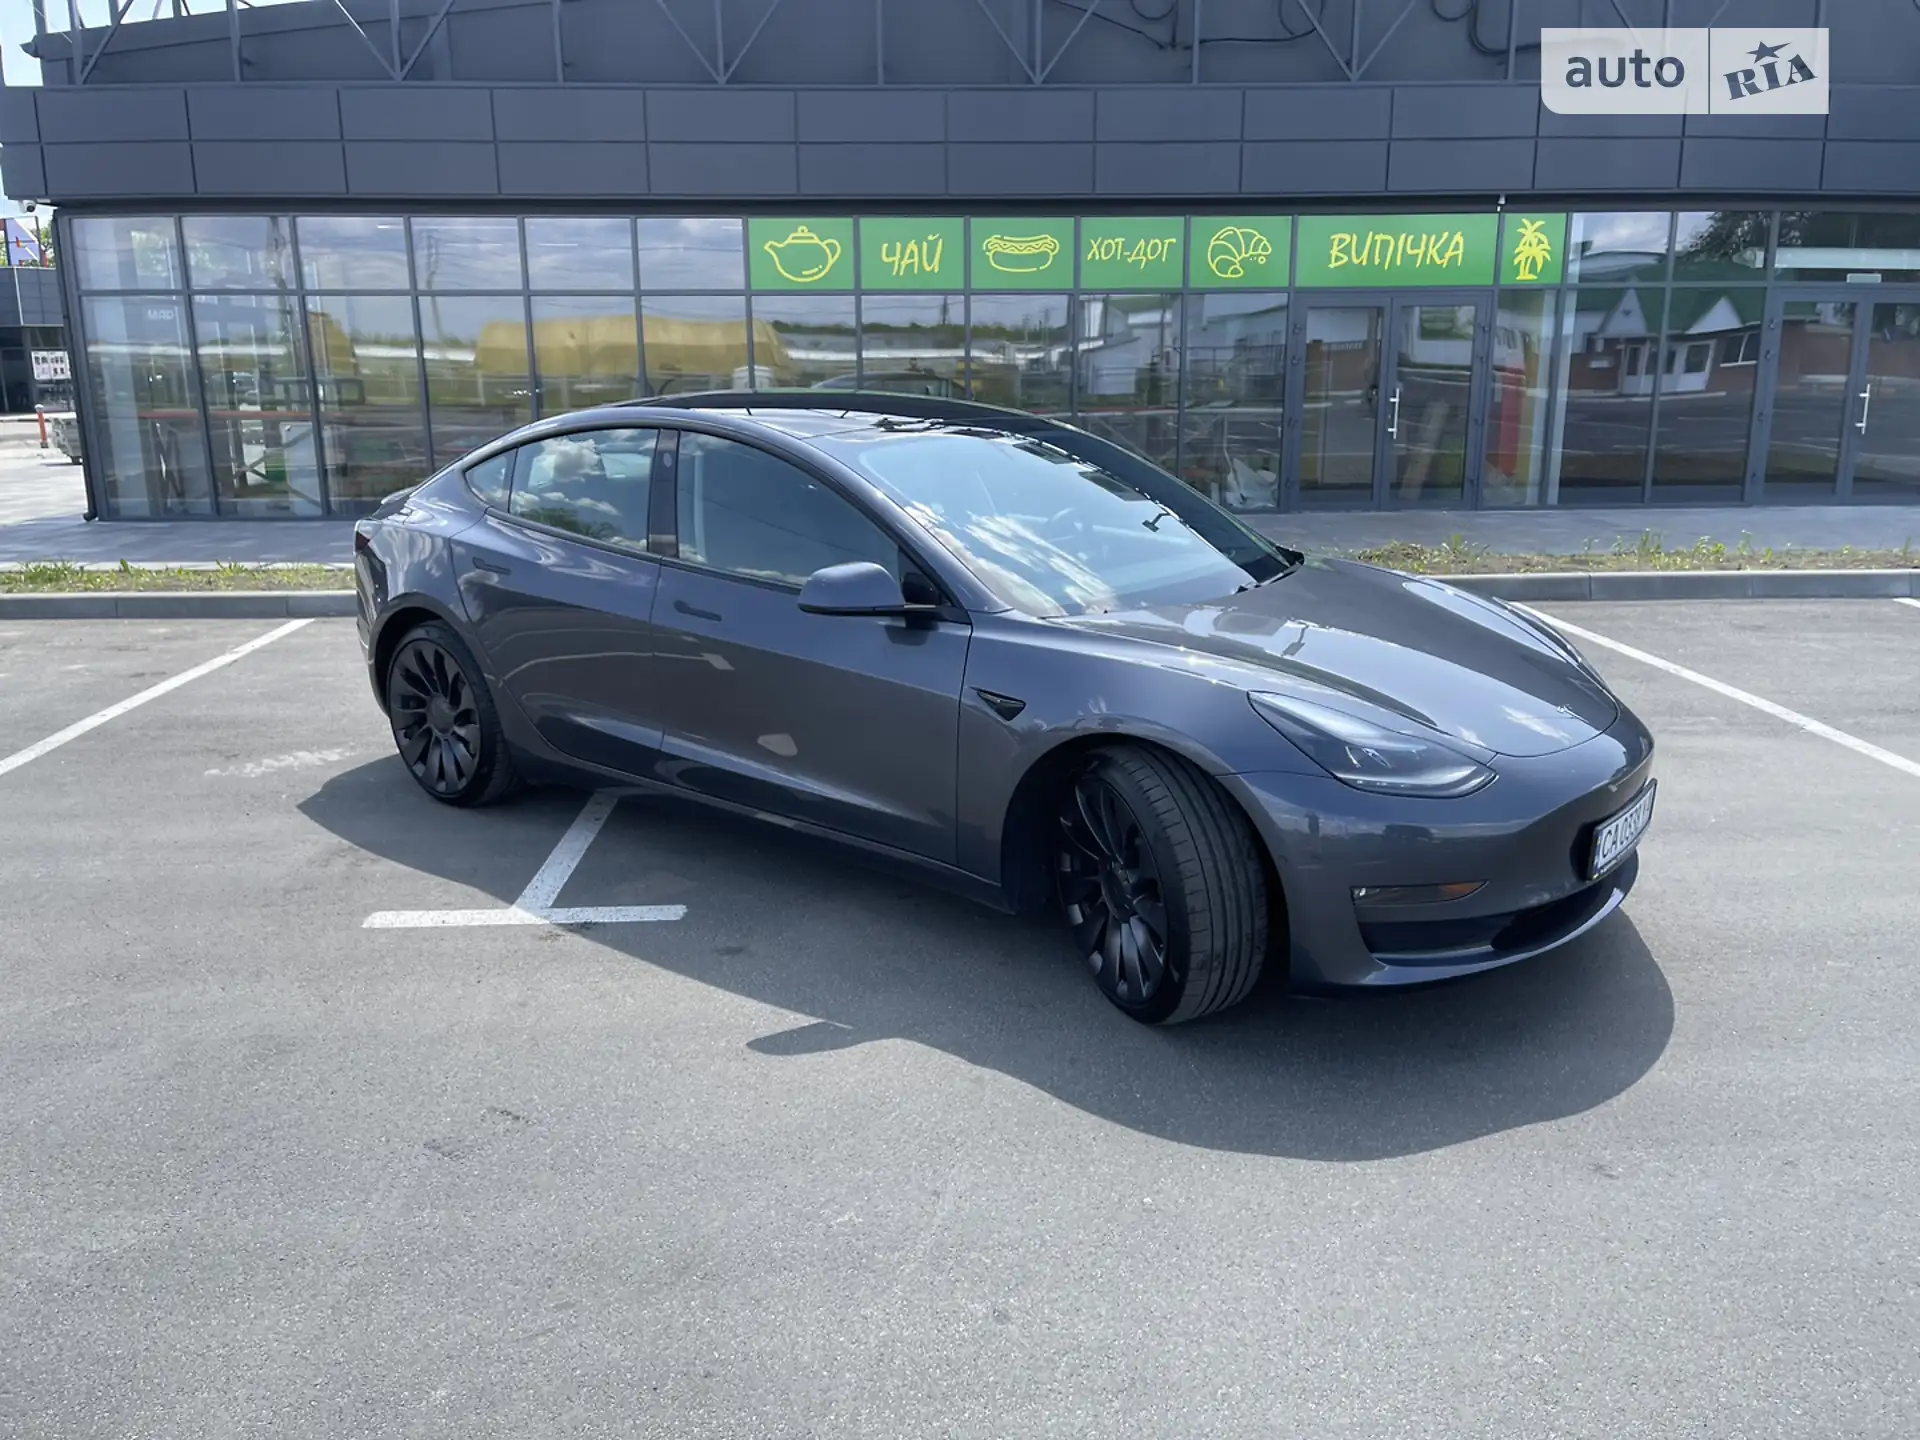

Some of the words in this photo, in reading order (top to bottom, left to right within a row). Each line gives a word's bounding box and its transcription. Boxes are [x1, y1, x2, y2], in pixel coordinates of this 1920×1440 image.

[881, 232, 944, 276] ЧАЙ
[1087, 236, 1177, 270] ХОТ-ДОГ
[1328, 230, 1466, 271] ВИПІЧКА
